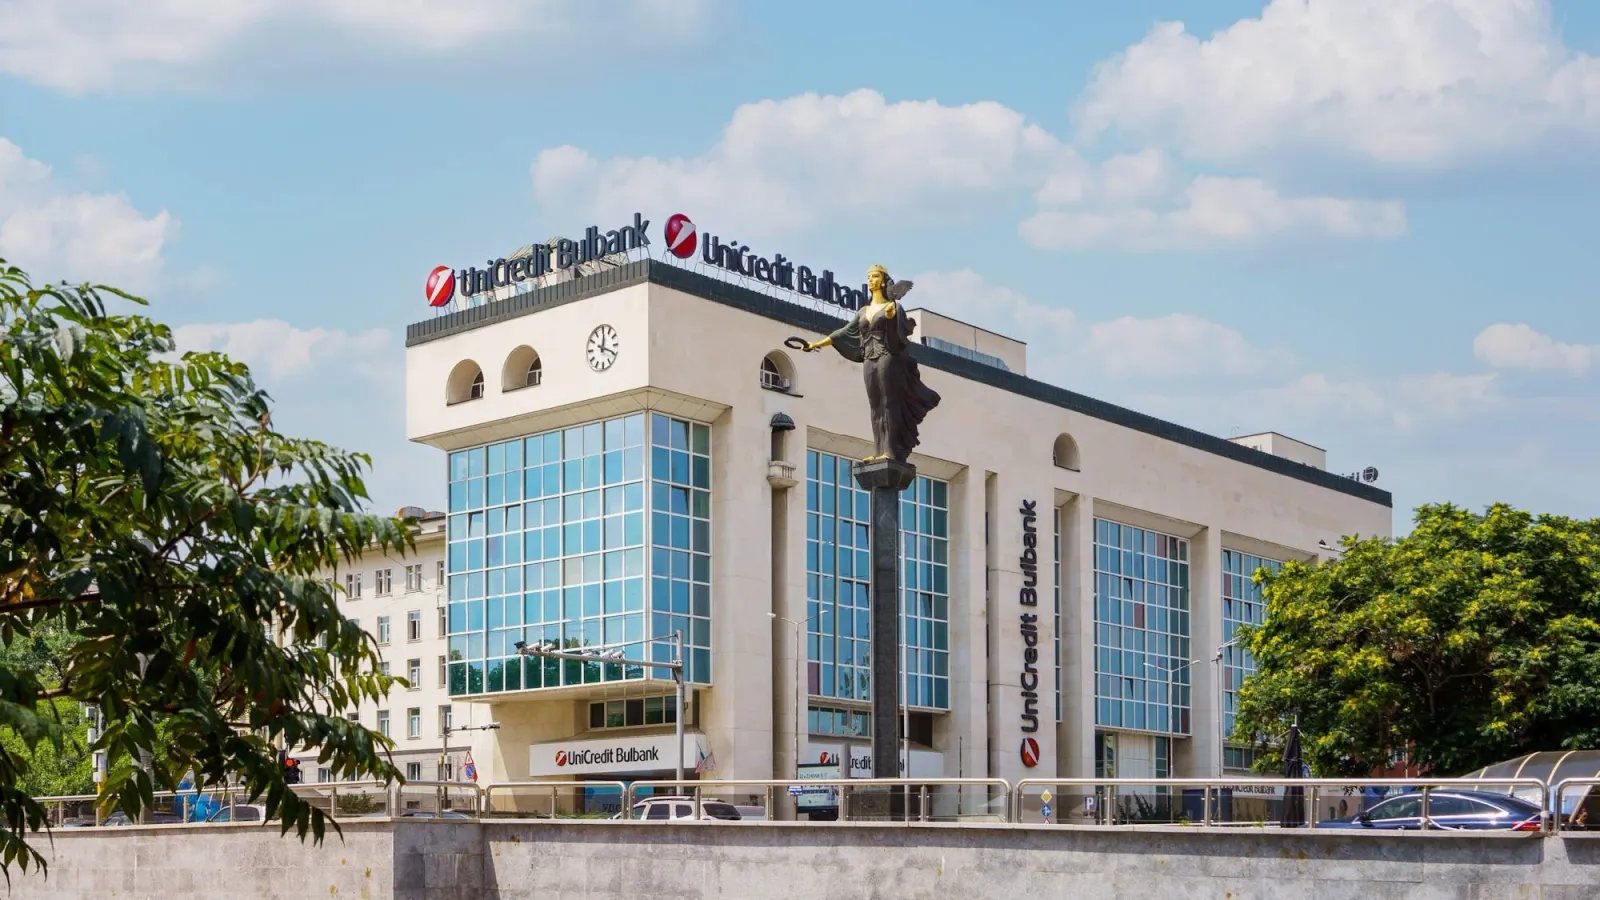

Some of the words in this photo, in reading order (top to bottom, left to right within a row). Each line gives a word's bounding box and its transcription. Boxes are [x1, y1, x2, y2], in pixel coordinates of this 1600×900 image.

[460, 243, 553, 297] UniCredit
[556, 212, 651, 270] Bulbank
[702, 232, 795, 290] UniCredit
[1019, 499, 1037, 607] Bulbank
[1020, 613, 1039, 732] UniCredit
[568, 749, 613, 766] UniCredit
[616, 745, 659, 763] Bulbank
[1086, 796, 1094, 810] P
